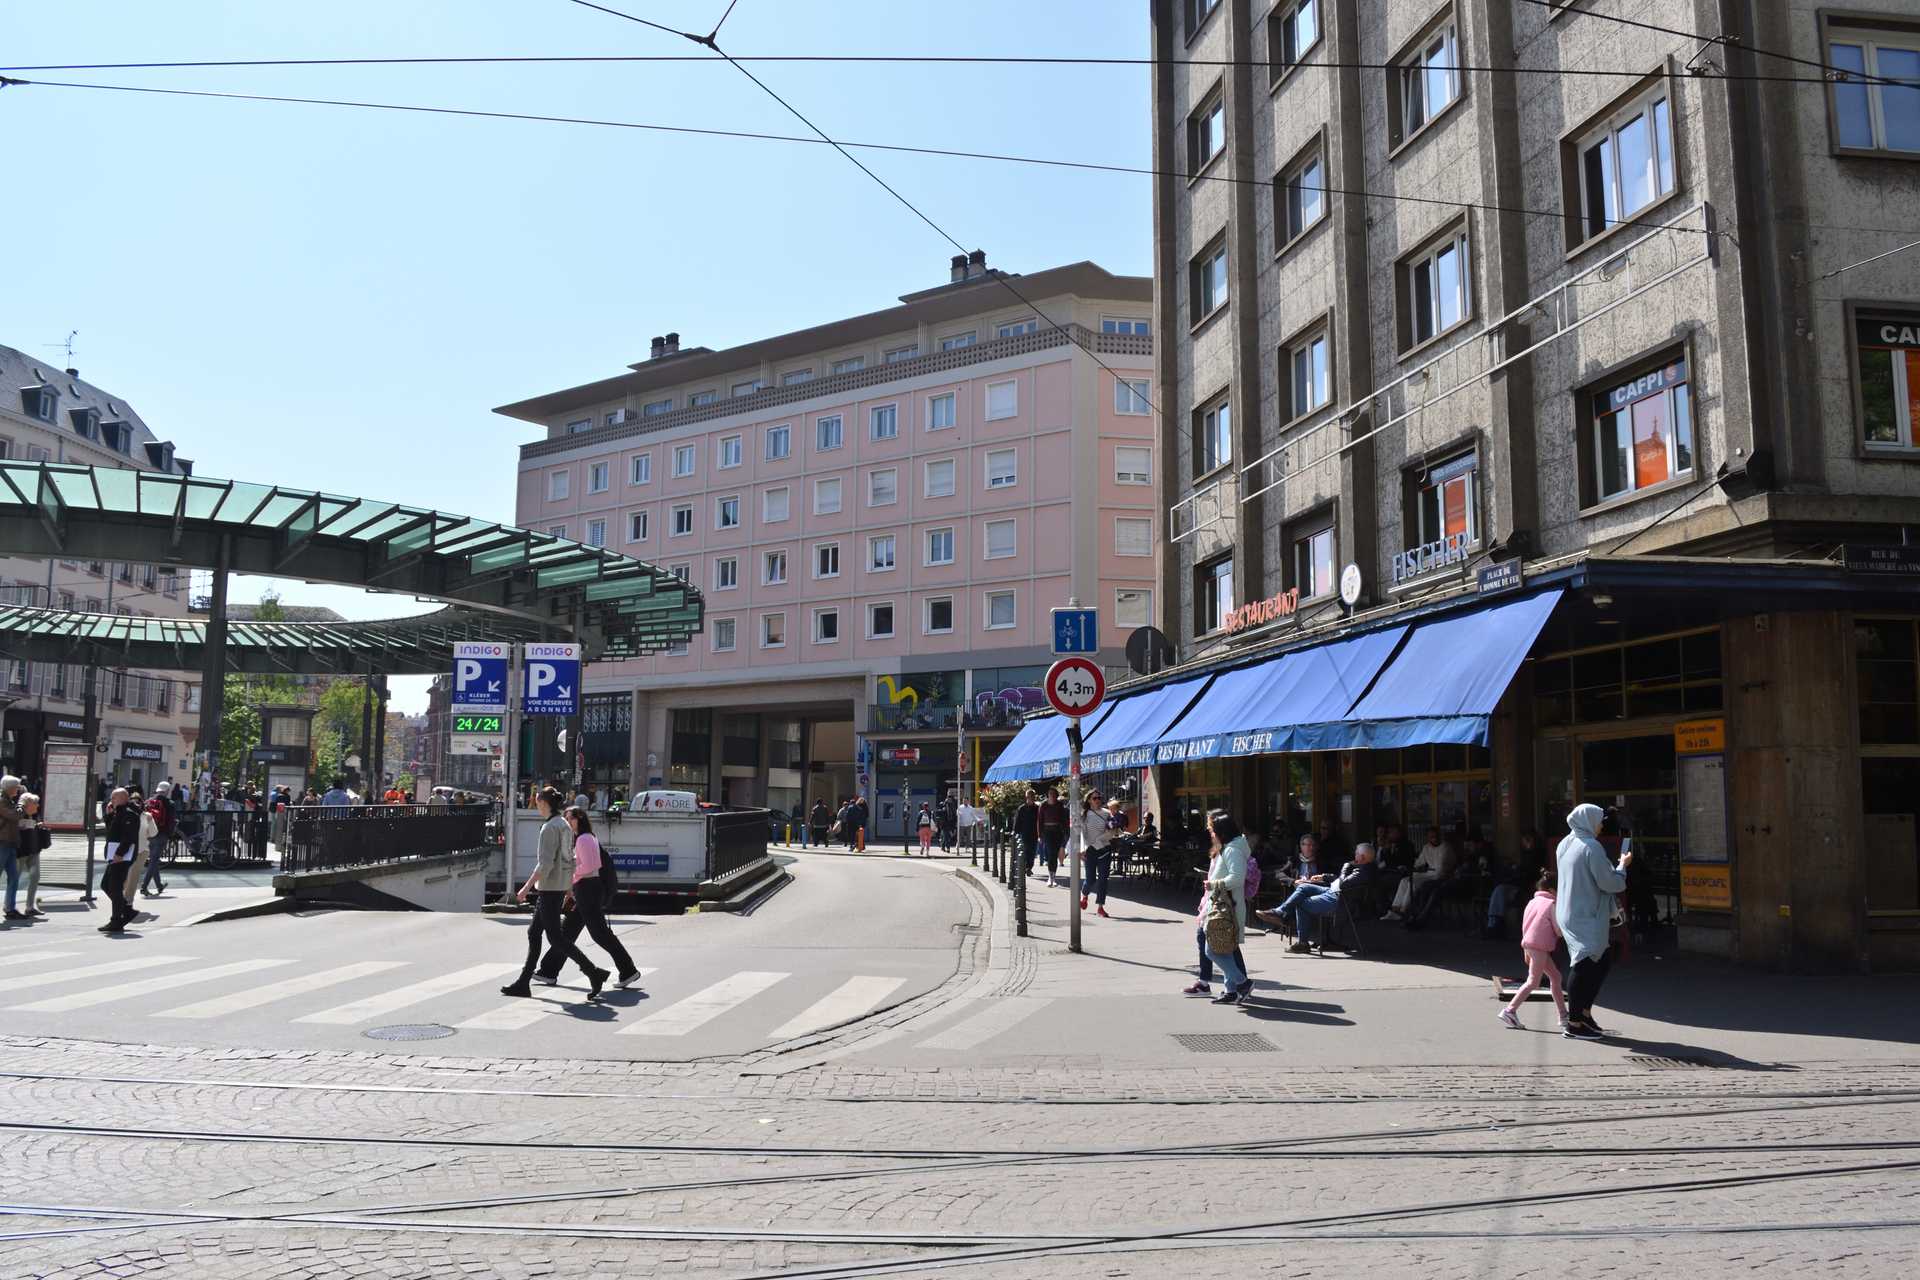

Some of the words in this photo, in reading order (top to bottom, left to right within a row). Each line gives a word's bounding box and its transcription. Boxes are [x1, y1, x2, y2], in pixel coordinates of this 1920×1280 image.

[1880, 325, 1920, 344] CA
[1614, 370, 1663, 403] CAFPI
[1391, 532, 1469, 584] FISCHER
[1224, 586, 1299, 635] RESTAURANT
[459, 645, 502, 656] INDIGO
[531, 647, 573, 656] INDIGO
[456, 659, 482, 692] P
[528, 663, 556, 698] P
[1057, 679, 1095, 697] 4,3m
[527, 705, 573, 713] ABONNÉS
[456, 718, 500, 731] 24/24
[1158, 739, 1216, 760] RESTAURANT
[1231, 733, 1273, 753] FISCHER
